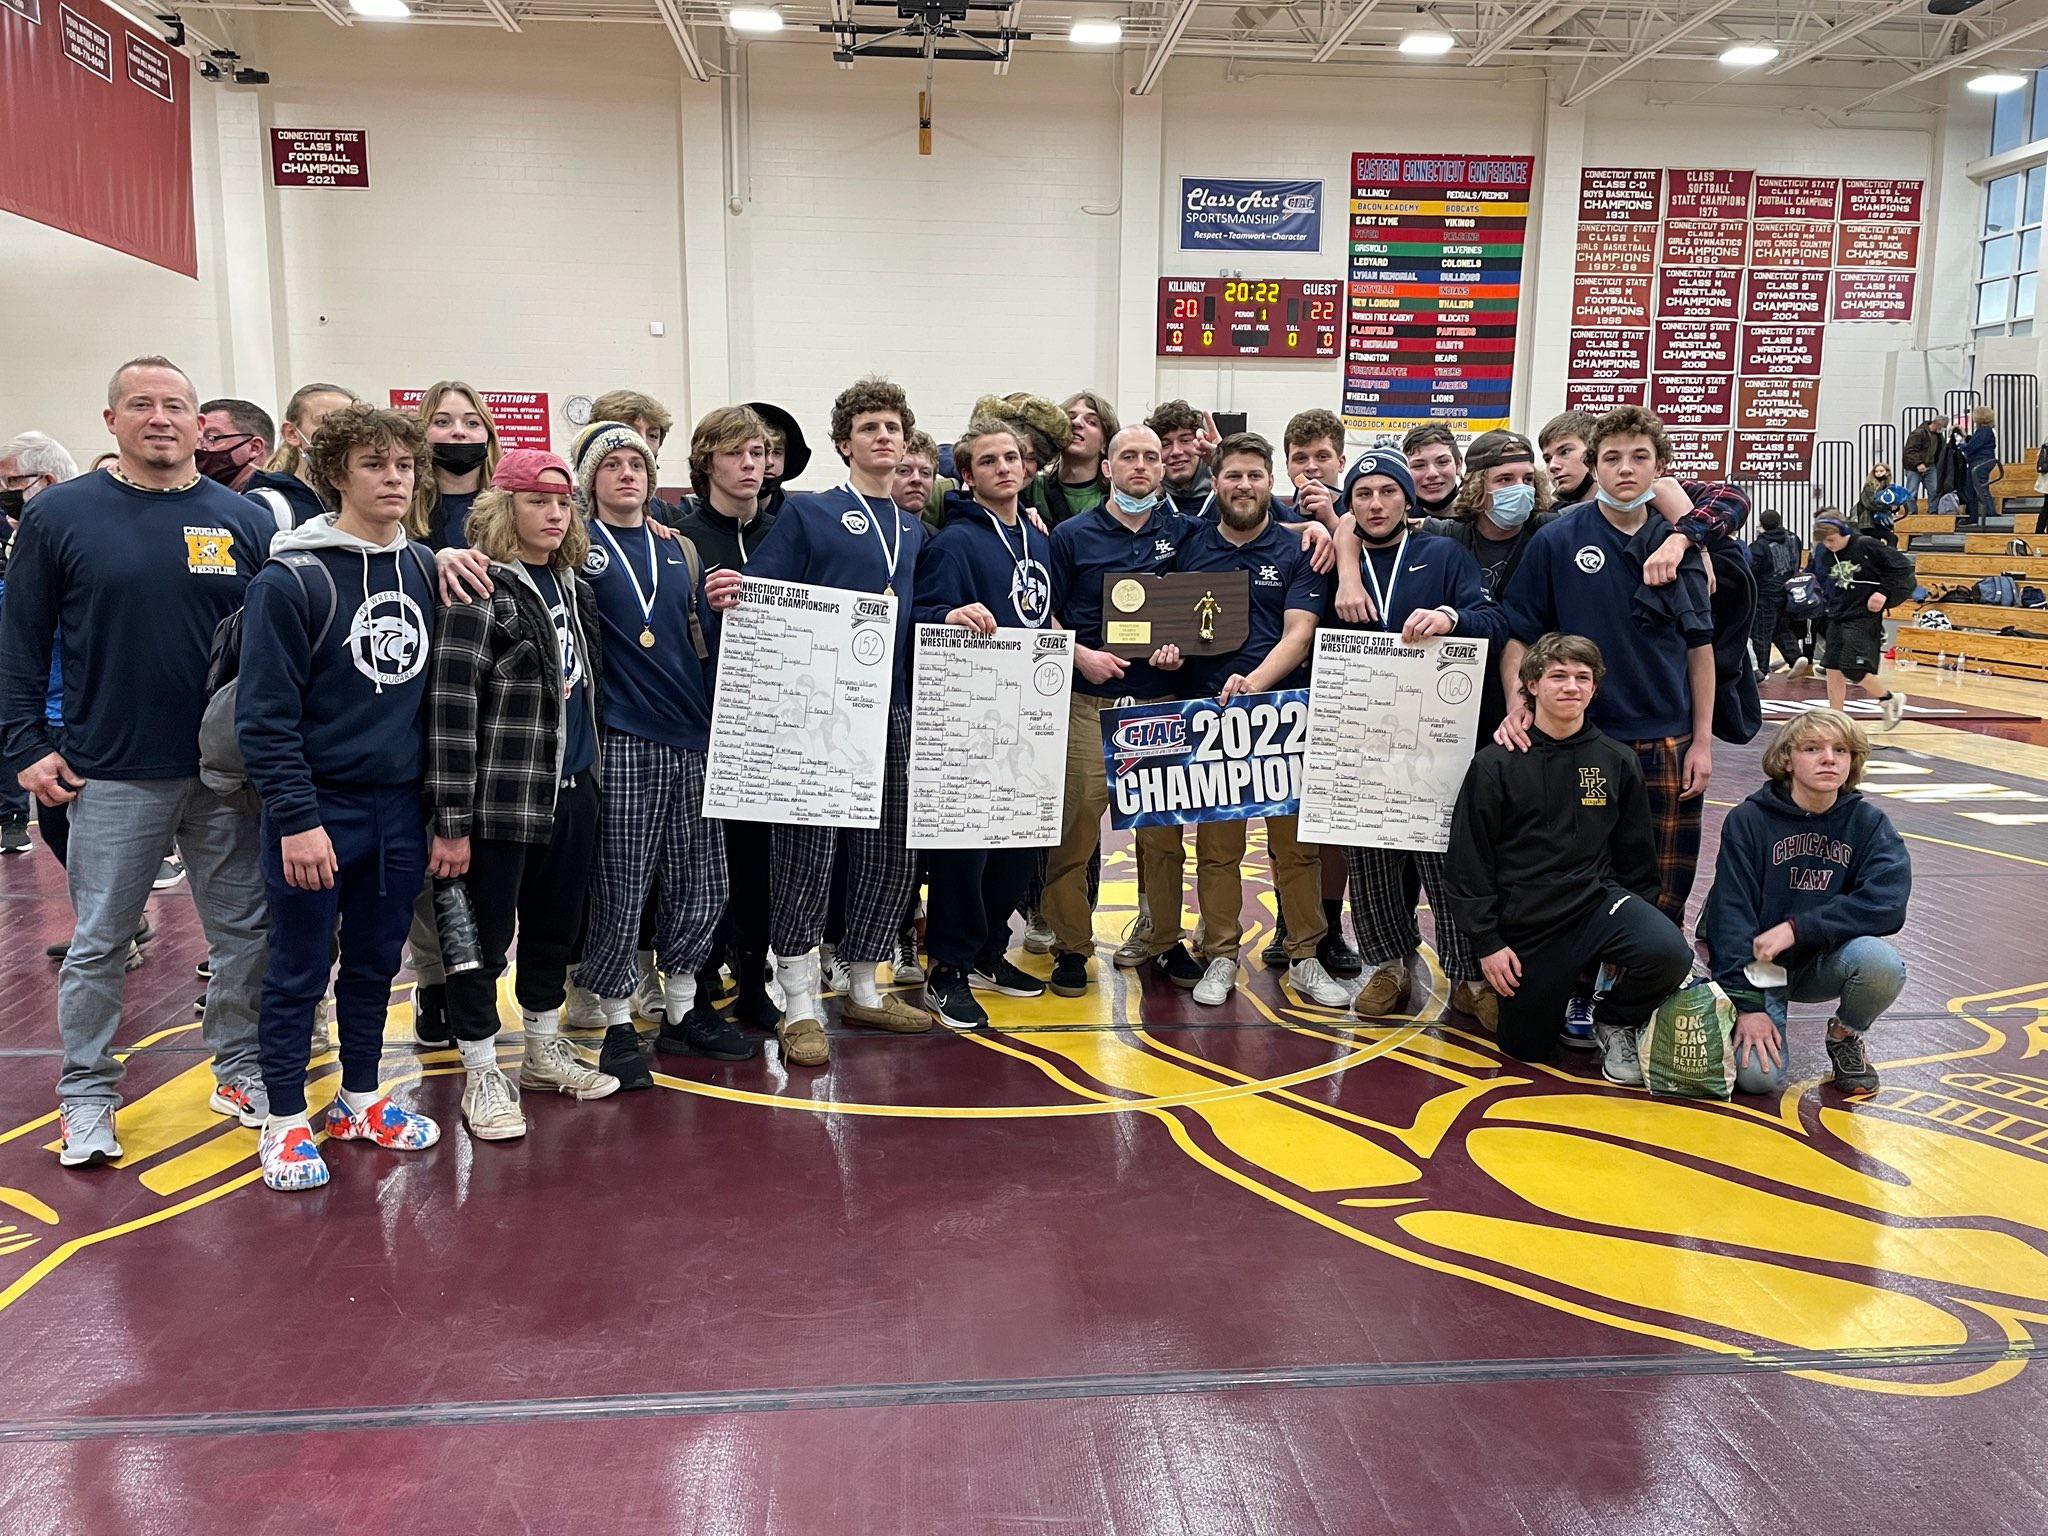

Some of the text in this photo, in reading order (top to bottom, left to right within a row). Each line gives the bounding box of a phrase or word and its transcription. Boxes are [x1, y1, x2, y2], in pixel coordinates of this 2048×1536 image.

[66, 27, 76, 41] FOR
[96, 44, 106, 59] CALL
[278, 131, 358, 142] CONNECTICUT STATE
[294, 142, 331, 151] CLASS
[289, 153, 350, 162] FOOTBALL
[282, 163, 359, 174] CHAMPIONS
[1357, 159, 1527, 184] EASTERN CONNECTICUT CONFERENCE
[307, 176, 336, 184] 2021
[1634, 172, 1656, 180] STATE
[1687, 172, 1714, 182] CLASS
[1593, 181, 1626, 189] CLASS
[1688, 184, 1730, 194] SOFTBALL
[1759, 179, 1835, 189] CONNECTICUT STATE
[1846, 180, 1919, 190] CONNECTICUT STATE
[1358, 189, 1391, 197] KILLINGLY
[1584, 190, 1654, 199] BOYS BASKETBALL
[1187, 188, 1234, 210] Class
[1236, 191, 1279, 213] Act
[1672, 196, 1746, 207] STATE CHAMPIONS
[1758, 197, 1793, 206] FOOTBALL
[1882, 196, 1912, 204] TRACK
[1357, 203, 1480, 213] BACON ACADEMY BOBCATS
[1584, 201, 1652, 210] CHAMPIONS
[1853, 204, 1910, 213] CHAMPIONS
[1699, 207, 1718, 217] 1976
[1186, 212, 1279, 225] SPORTSMANSHIP
[1356, 217, 1475, 228] EAST LYME VIKINGS
[1577, 224, 1656, 233] CONNECTICUT STATE
[1670, 222, 1743, 231] CONNECTICUT STATE
[1355, 245, 1482, 255] GRISWOLD WOLVERINES
[1669, 247, 1739, 256] CHAMPIONS
[1756, 249, 1829, 259] CHAMPIONS
[1846, 250, 1908, 260] CHAMPIONS
[1577, 253, 1650, 262] CHAMPIONS
[1354, 258, 1481, 268] LEDYARD COLONELS
[1168, 281, 1206, 293] KILLINGLY
[1626, 279, 1647, 287] STATE
[1225, 283, 1280, 303] 20:22
[1303, 284, 1337, 295] GUEST
[1440, 287, 1469, 295] INDIANS
[1757, 292, 1817, 300] GYMNASTICS
[1666, 298, 1732, 307] CHAMPIONS
[1753, 301, 1819, 312] CHAMPIONS
[1841, 301, 1905, 310] CHAMPIONS
[1174, 300, 1198, 318] 20
[1311, 302, 1334, 320] 22
[1577, 307, 1644, 316] CHAMPIONS
[1261, 309, 1267, 320] 1
[1173, 331, 1182, 344] 0
[1203, 331, 1212, 345] 0
[1288, 332, 1297, 347] 0
[1324, 333, 1333, 346] 0
[1435, 355, 1458, 363] BEARS
[1663, 351, 1726, 360] CHAMPIONS
[1750, 355, 1812, 364] CHAMPIONS
[1573, 360, 1640, 369] CHAMPIONS
[1593, 370, 1619, 378] 2007
[1666, 386, 1705, 394] DIVISION
[1347, 393, 1454, 403] WHEELER LIONS
[1658, 405, 1723, 414] CHAMPIONS
[1746, 409, 1809, 418] CHAMPIONS
[1344, 420, 1385, 428] WOODSTOCK
[184, 526, 232, 536] COUGARS
[189, 566, 237, 576] WRESTLING
[1259, 566, 1279, 581] HK
[786, 586, 809, 600] STATE
[370, 592, 417, 611] WRESTING
[778, 597, 840, 614] CHAMPIONSHIPS
[859, 602, 889, 617] CIAC
[921, 628, 970, 638] CONNECTICUT
[920, 637, 1022, 651] WRESTLING CHAMPIONSHIPS
[1039, 637, 1068, 649] CIAC
[1321, 633, 1394, 647] CONNECTICUT STATE
[859, 636, 879, 657] 152
[1321, 643, 1425, 659] WRESTLING CHAMPIONSHIPS
[1445, 646, 1478, 658] CIAC
[1040, 668, 1059, 687] 195
[1443, 677, 1469, 696] 160
[1124, 701, 1308, 763] CIAC 2022
[1579, 768, 1607, 798] HK
[1772, 832, 1854, 867] CHICAGO
[1790, 867, 1834, 891] LAW
[1675, 1014, 1705, 1031] ONE
[1675, 1029, 1707, 1045] BAG
[1674, 1045, 1708, 1058] FOR A
[1674, 1056, 1708, 1067] BETTER
[1673, 1063, 1708, 1074] TOMORROW
